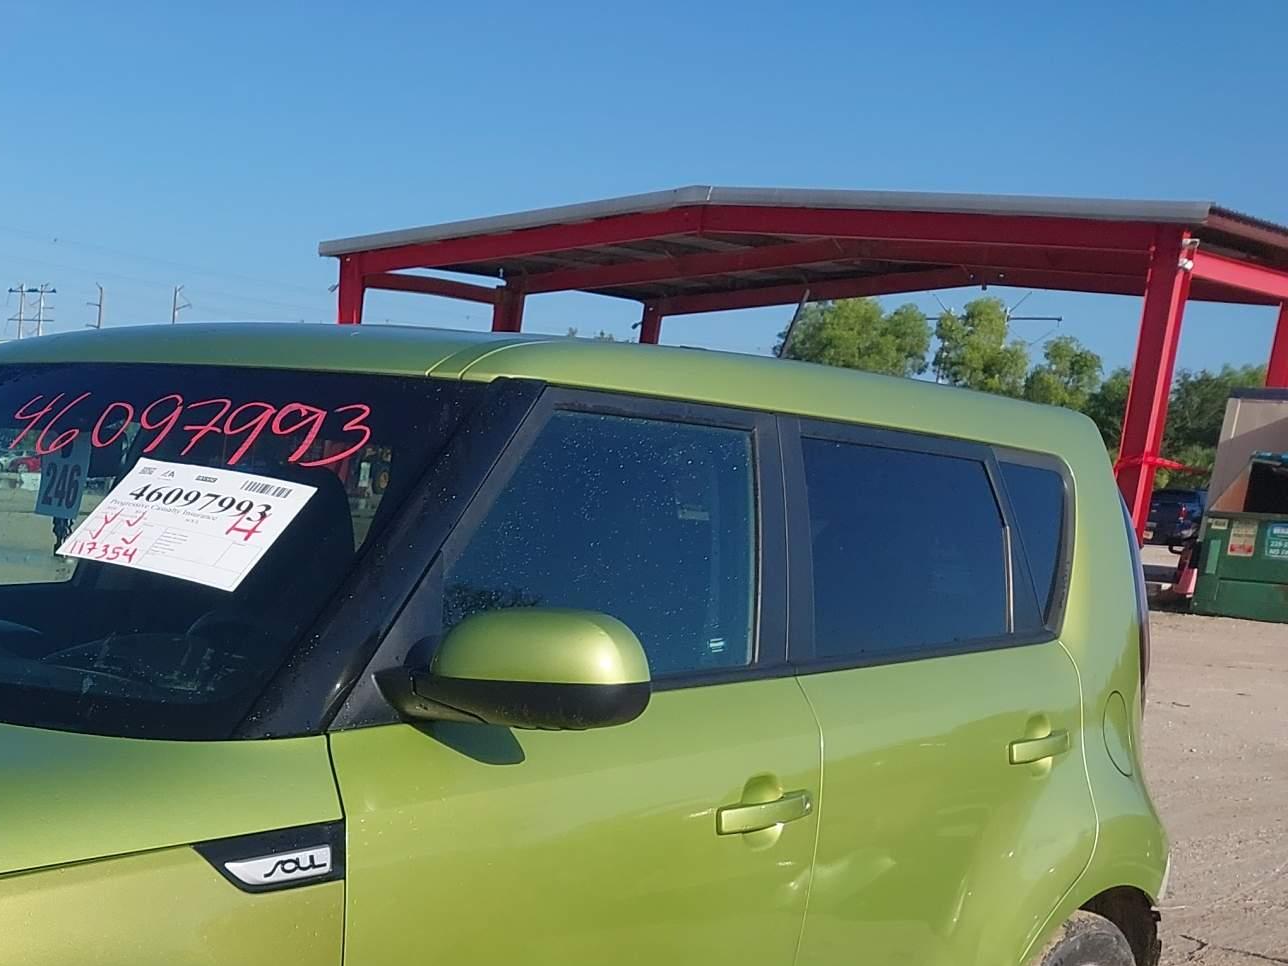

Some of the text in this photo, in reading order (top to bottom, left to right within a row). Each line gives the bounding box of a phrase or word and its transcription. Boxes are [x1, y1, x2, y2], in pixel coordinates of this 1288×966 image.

[8, 391, 372, 468] 46097993
[41, 462, 82, 509] 246
[129, 483, 272, 523] 46097993
[70, 541, 138, 563] 117354
[263, 854, 327, 878] SOUL
